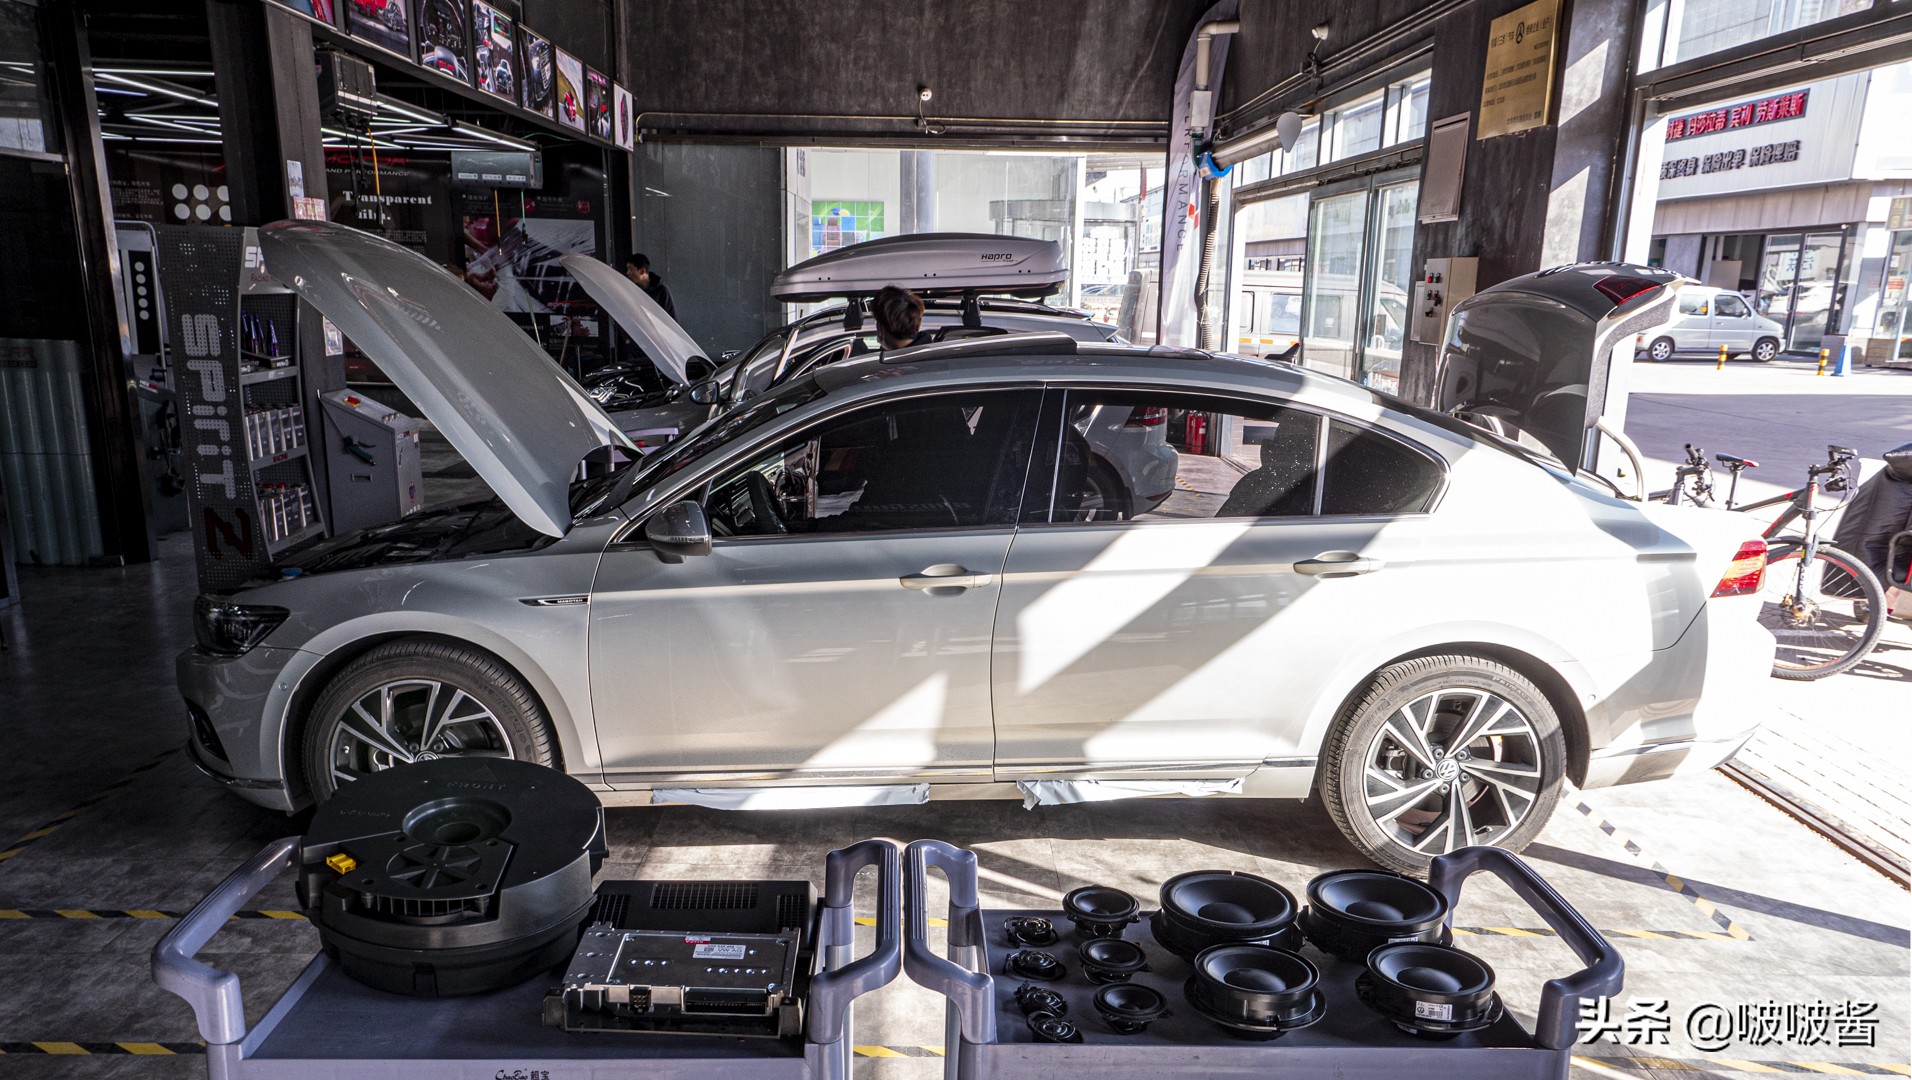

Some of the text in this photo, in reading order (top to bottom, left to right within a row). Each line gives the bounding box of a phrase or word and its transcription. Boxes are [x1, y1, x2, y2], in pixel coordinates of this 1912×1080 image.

[1687, 109, 1728, 135] 玛莎拉蒂
[1729, 103, 1755, 128] 宾利
[1755, 92, 1807, 123] 劳斯莱斯
[344, 168, 411, 177] PROMANCE
[1701, 149, 1747, 174] 保险出单
[1749, 140, 1801, 167] 保险理赔
[1176, 102, 1192, 252] ERFORMANCE
[981, 253, 1012, 261] Hapro
